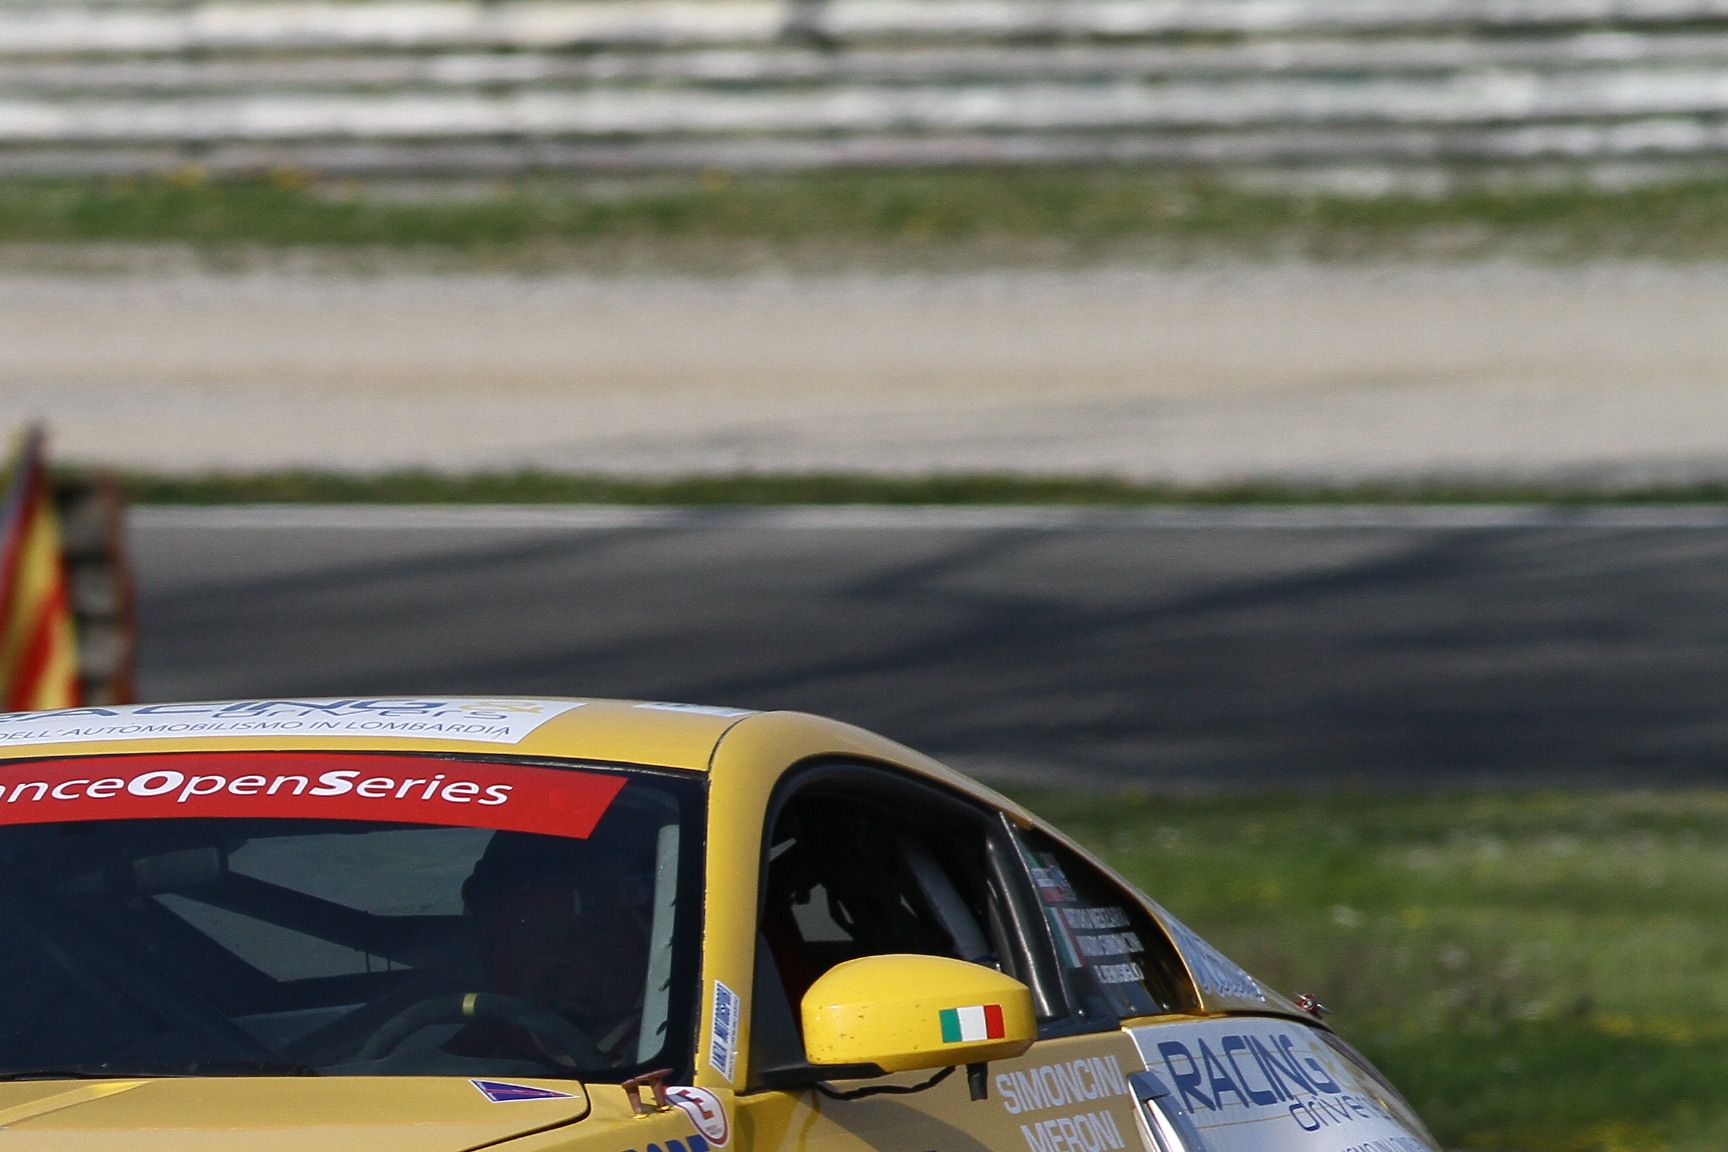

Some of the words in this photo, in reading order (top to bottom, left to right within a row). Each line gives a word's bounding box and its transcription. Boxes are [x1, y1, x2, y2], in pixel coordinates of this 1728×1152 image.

[309, 721, 334, 731] IN
[354, 721, 510, 736] LOMBARDIA
[995, 1054, 1128, 1115] SIMONCINI
[1158, 1034, 1341, 1113] RACING
